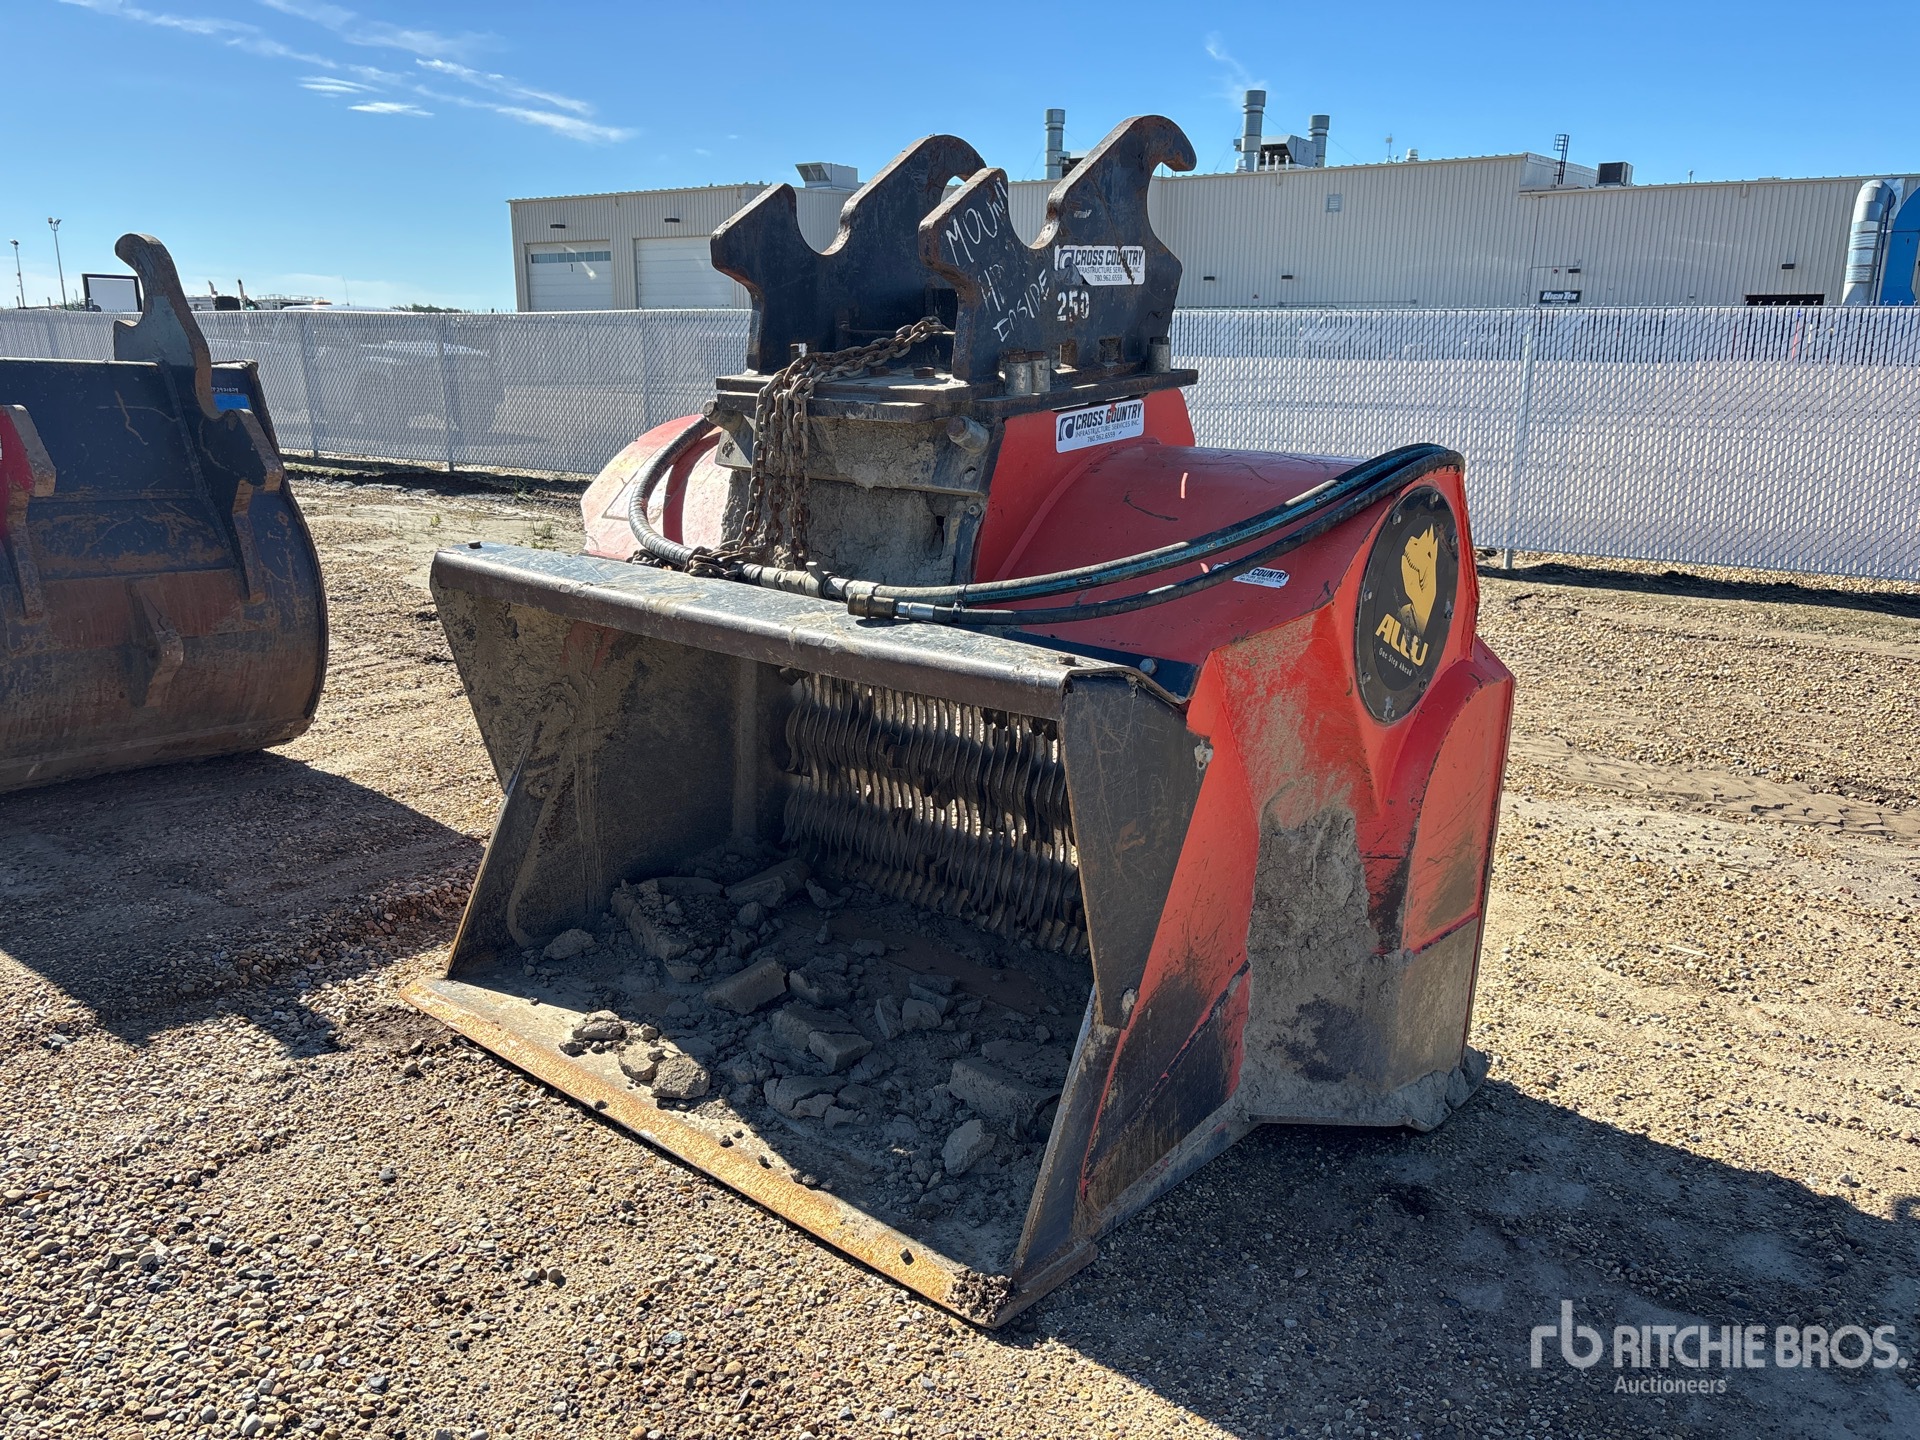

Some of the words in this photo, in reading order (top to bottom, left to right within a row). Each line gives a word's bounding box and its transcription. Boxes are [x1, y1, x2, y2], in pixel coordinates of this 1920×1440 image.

[1075, 250, 1104, 266] CROSS
[1106, 250, 1143, 266] COUNTRY
[1057, 290, 1090, 322] 250
[1075, 426, 1111, 438] INFRASTRUCTURE
[1112, 421, 1131, 431] SERVICES
[1076, 410, 1104, 430] CROSS
[1106, 403, 1143, 424] COUNTRY
[1251, 568, 1288, 580] COUNTRY
[1375, 613, 1429, 666] ALLU
[1378, 647, 1388, 659] One
[1388, 654, 1398, 669] Step
[1399, 661, 1413, 677] Ahead
